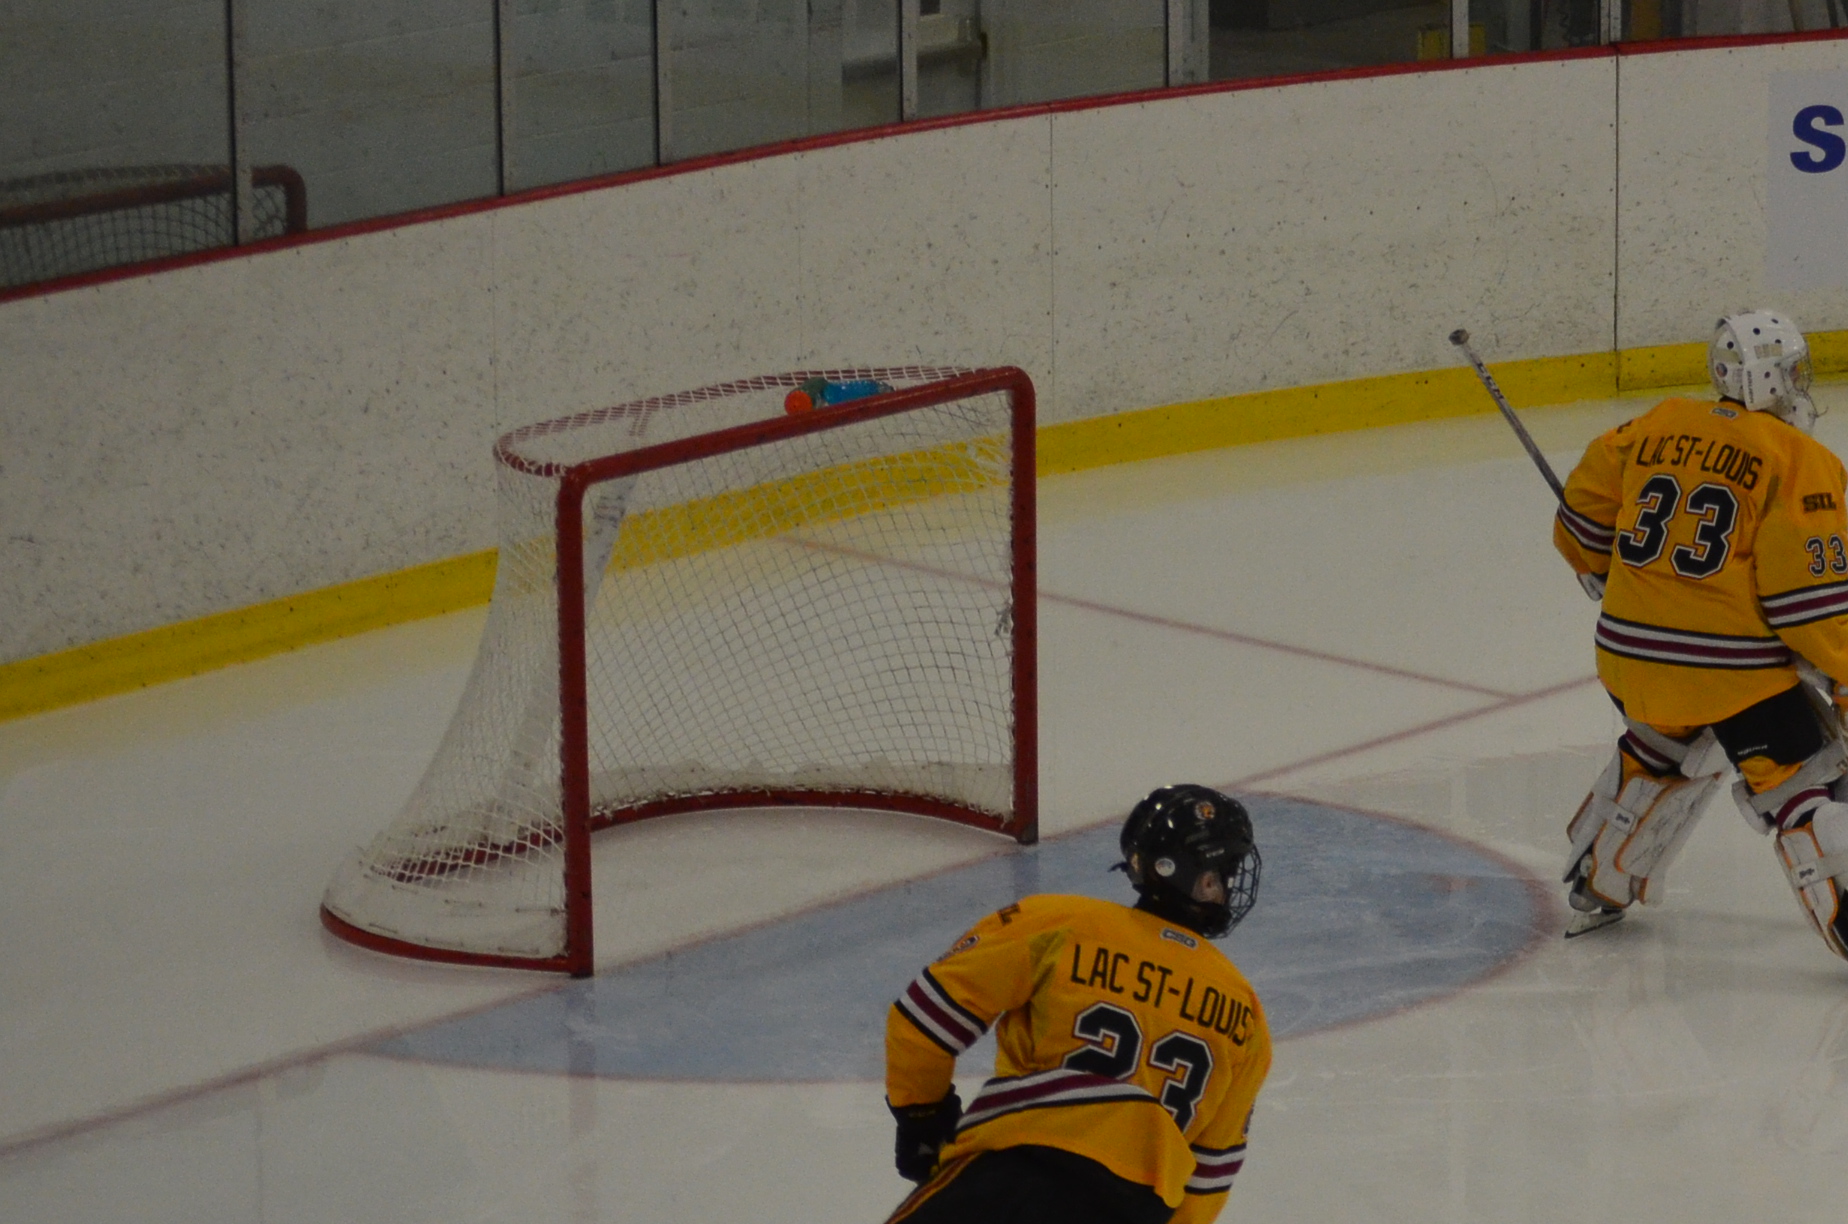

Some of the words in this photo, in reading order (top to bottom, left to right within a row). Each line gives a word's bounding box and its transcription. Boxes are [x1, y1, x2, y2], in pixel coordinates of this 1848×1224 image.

[1671, 434, 1763, 490] ST-LOUIS
[1616, 472, 1739, 580] 33
[1805, 534, 1848, 577] 33
[1071, 943, 1130, 995] LAC
[1133, 961, 1253, 1047] ST-LOUIS
[1063, 1001, 1214, 1134] 23
